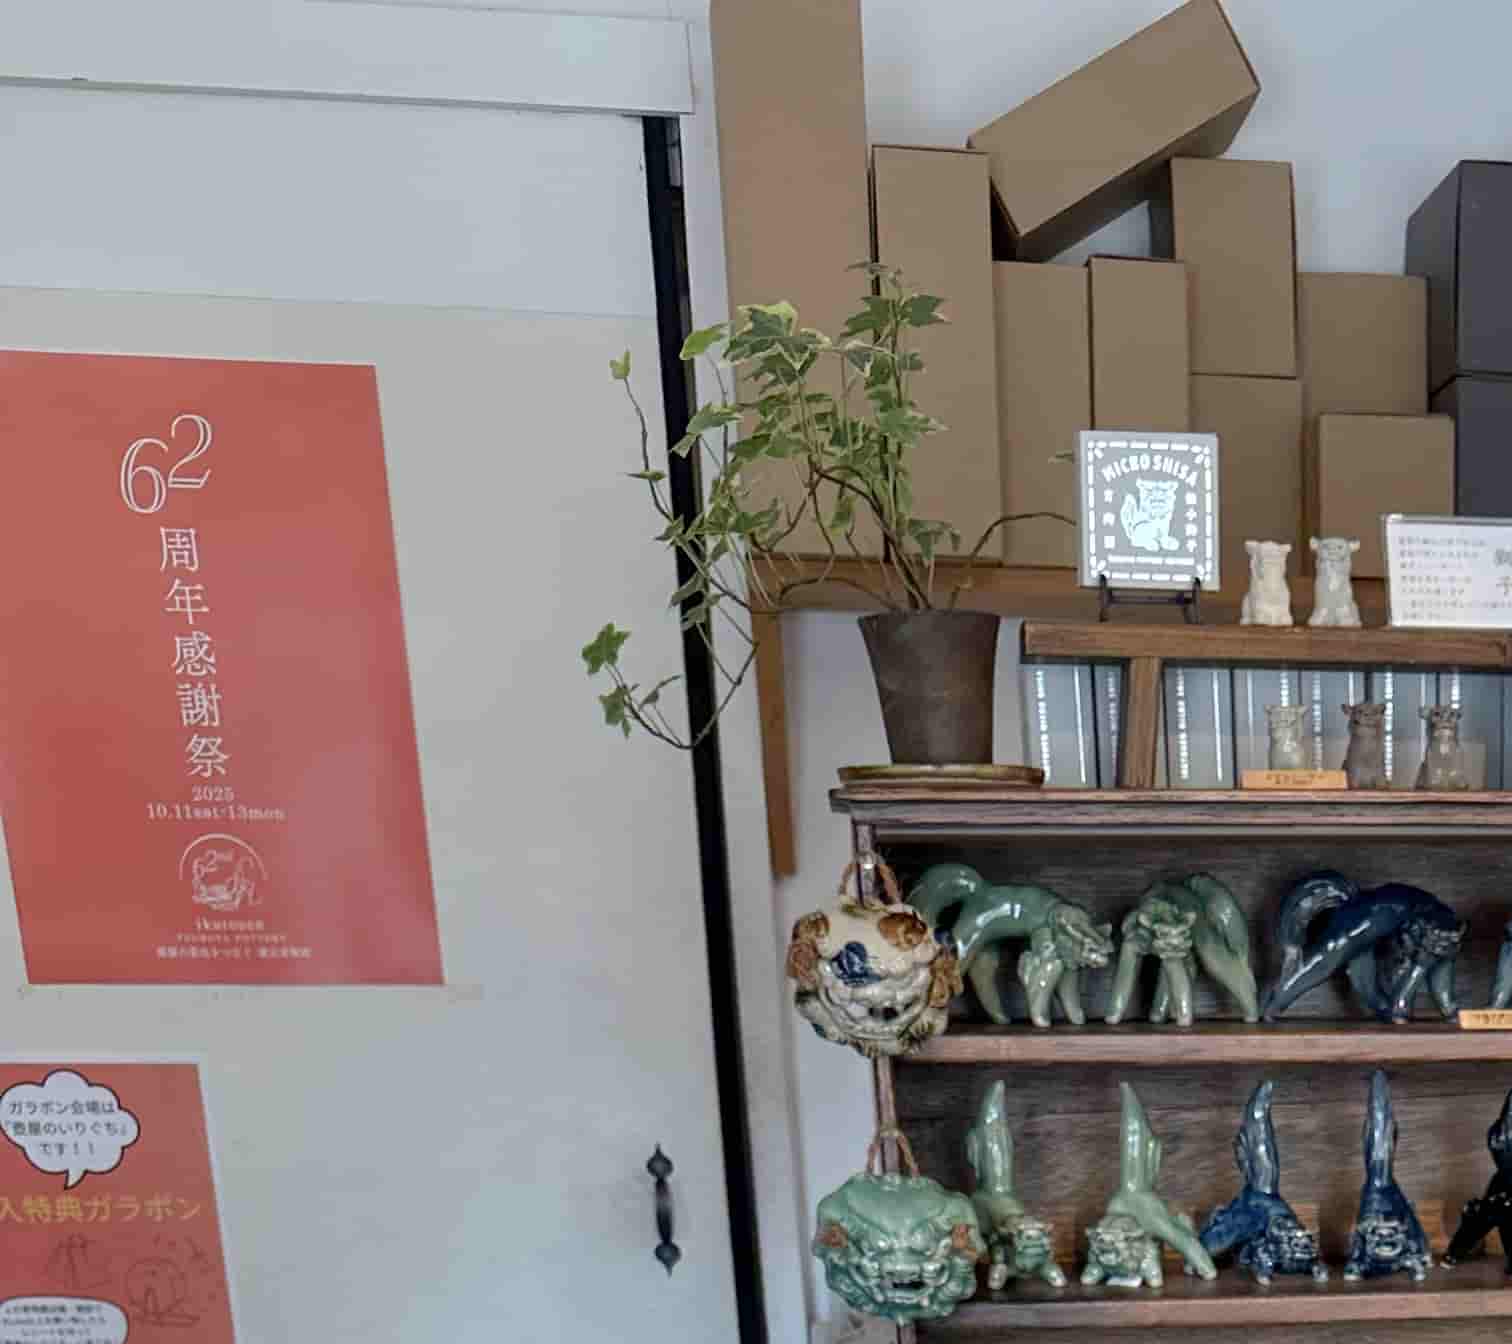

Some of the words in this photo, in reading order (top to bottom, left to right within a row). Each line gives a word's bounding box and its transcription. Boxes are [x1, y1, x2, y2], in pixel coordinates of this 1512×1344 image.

[119, 413, 213, 514] 62
[157, 525, 229, 778] 周年感謝祭
